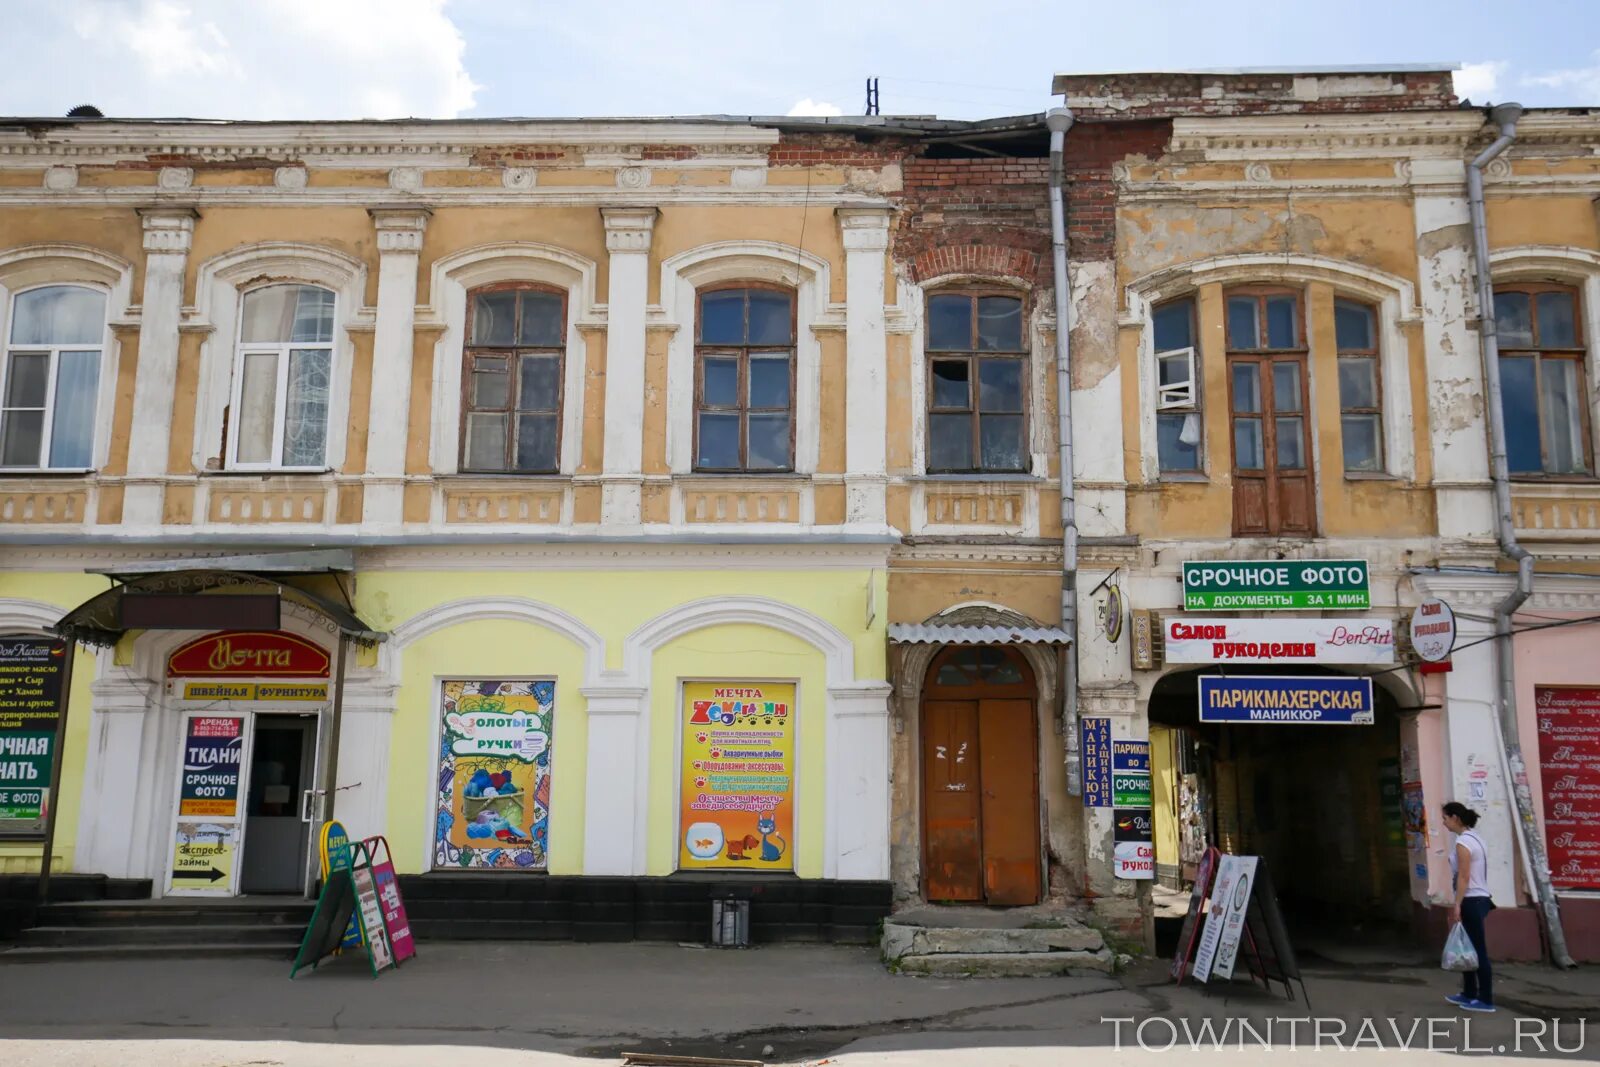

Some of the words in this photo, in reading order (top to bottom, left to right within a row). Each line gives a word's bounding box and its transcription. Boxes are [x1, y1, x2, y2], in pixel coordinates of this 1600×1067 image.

[1187, 568, 1289, 586] СРОЧНОЕ
[1301, 567, 1363, 585] ФОТО
[1188, 596, 1205, 606] НА
[1214, 595, 1293, 607] ДОКУМЕНТЫ
[1307, 595, 1324, 605] ЗА
[1327, 595, 1333, 605] 1
[1337, 594, 1368, 604] МИН.
[1171, 622, 1226, 640] Салон
[1326, 625, 1392, 646] LenArt
[208, 639, 291, 670] Мечта
[1213, 642, 1316, 659] рукоделия
[25, 676, 44, 686] Сыр
[16, 687, 43, 696] Хамон
[190, 685, 247, 697] ШВЕЙНАЯ
[259, 687, 327, 697] ФУРНИТУРА
[715, 689, 762, 698] МЕЧТА
[1209, 688, 1363, 710] ПАРИКМАХЕРСКАЯ
[1250, 710, 1322, 720] МАНИКЮР
[470, 718, 533, 728] ЗОЛОТЫЕ
[477, 740, 523, 749] РУЧКИ
[189, 747, 241, 763] ТКАНИ
[1085, 719, 1099, 806] МАНИКЮР
[1099, 719, 1110, 806] НАРАЩИВАНИЕ
[186, 775, 237, 785] СРОЧНОЕ
[195, 786, 225, 796] ФОТО
[12, 793, 39, 804] ФОТО
[179, 846, 228, 856] Экспресс-
[178, 857, 210, 866] займы
